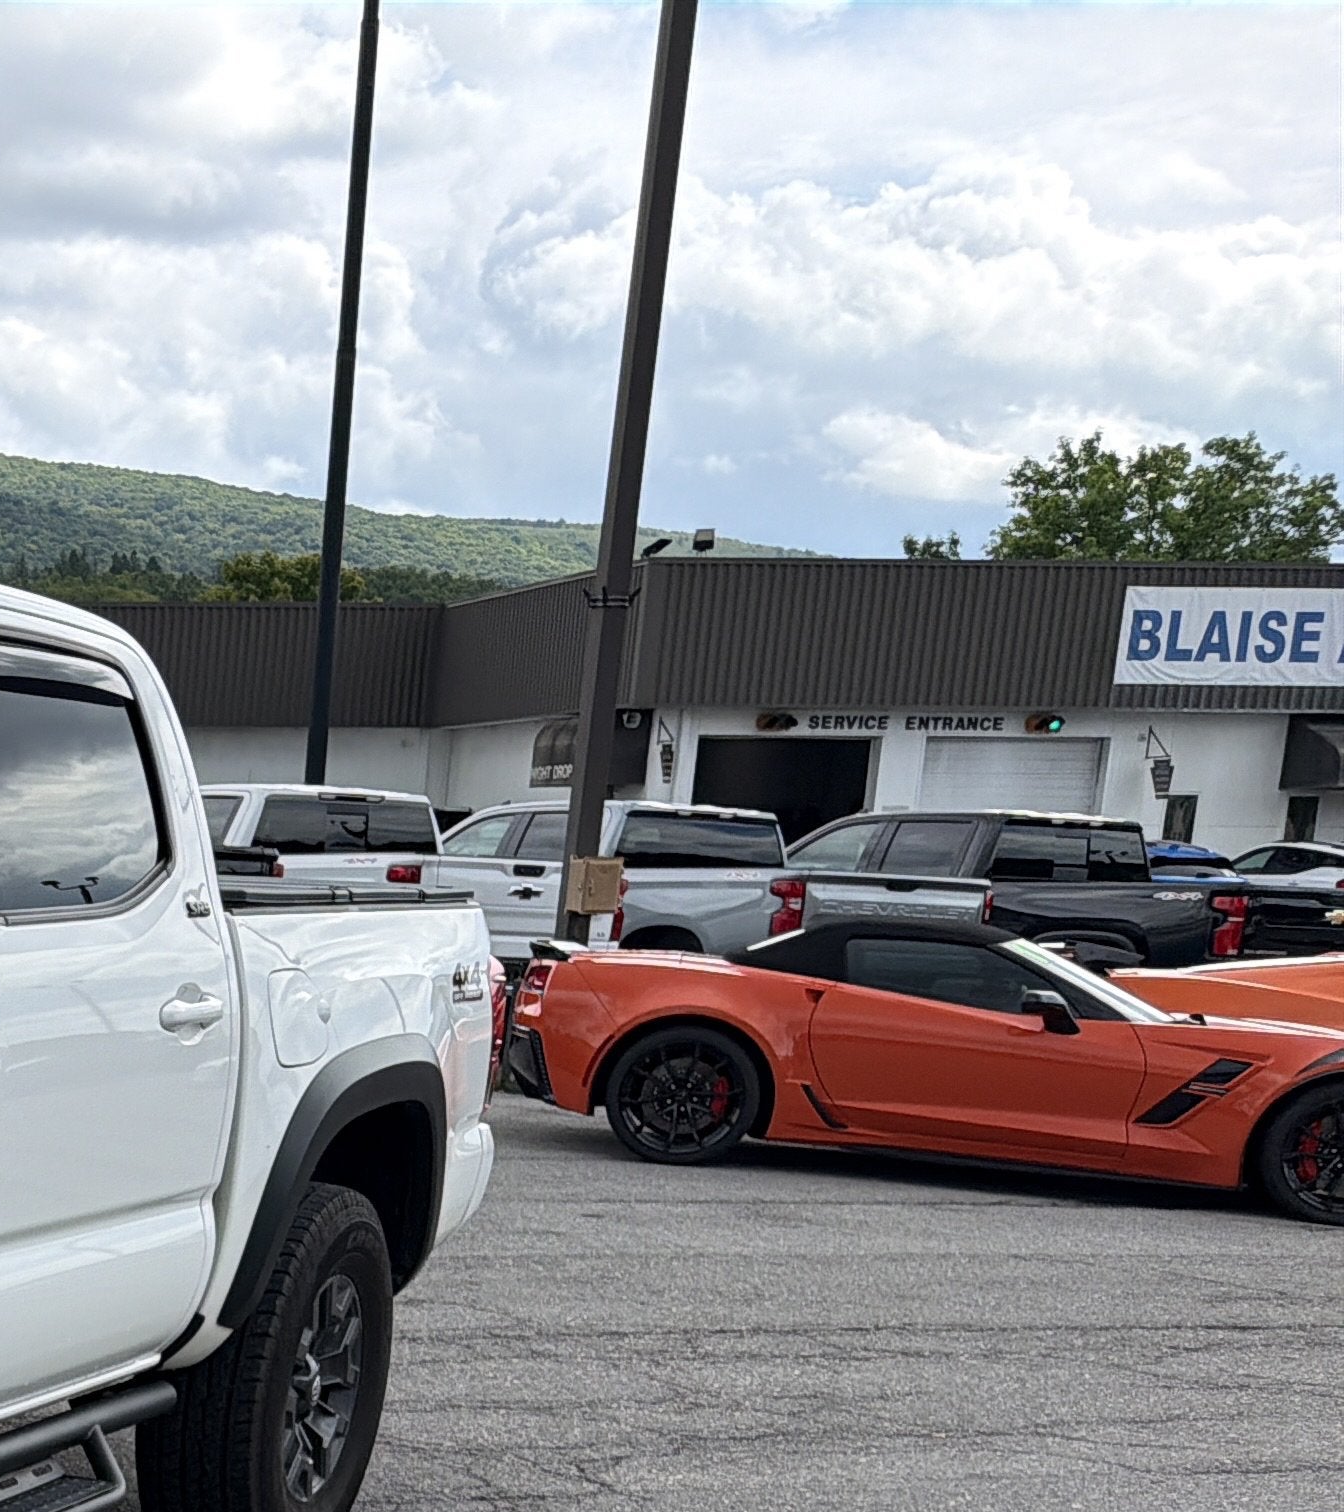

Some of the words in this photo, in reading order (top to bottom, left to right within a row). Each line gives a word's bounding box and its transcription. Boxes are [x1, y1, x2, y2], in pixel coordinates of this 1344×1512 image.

[1125, 609, 1325, 664] BLAISE
[808, 715, 890, 731] SERVICE
[904, 716, 1005, 732] ENTRANCE
[552, 763, 574, 780] DROP
[819, 901, 977, 921] CHEVROLET
